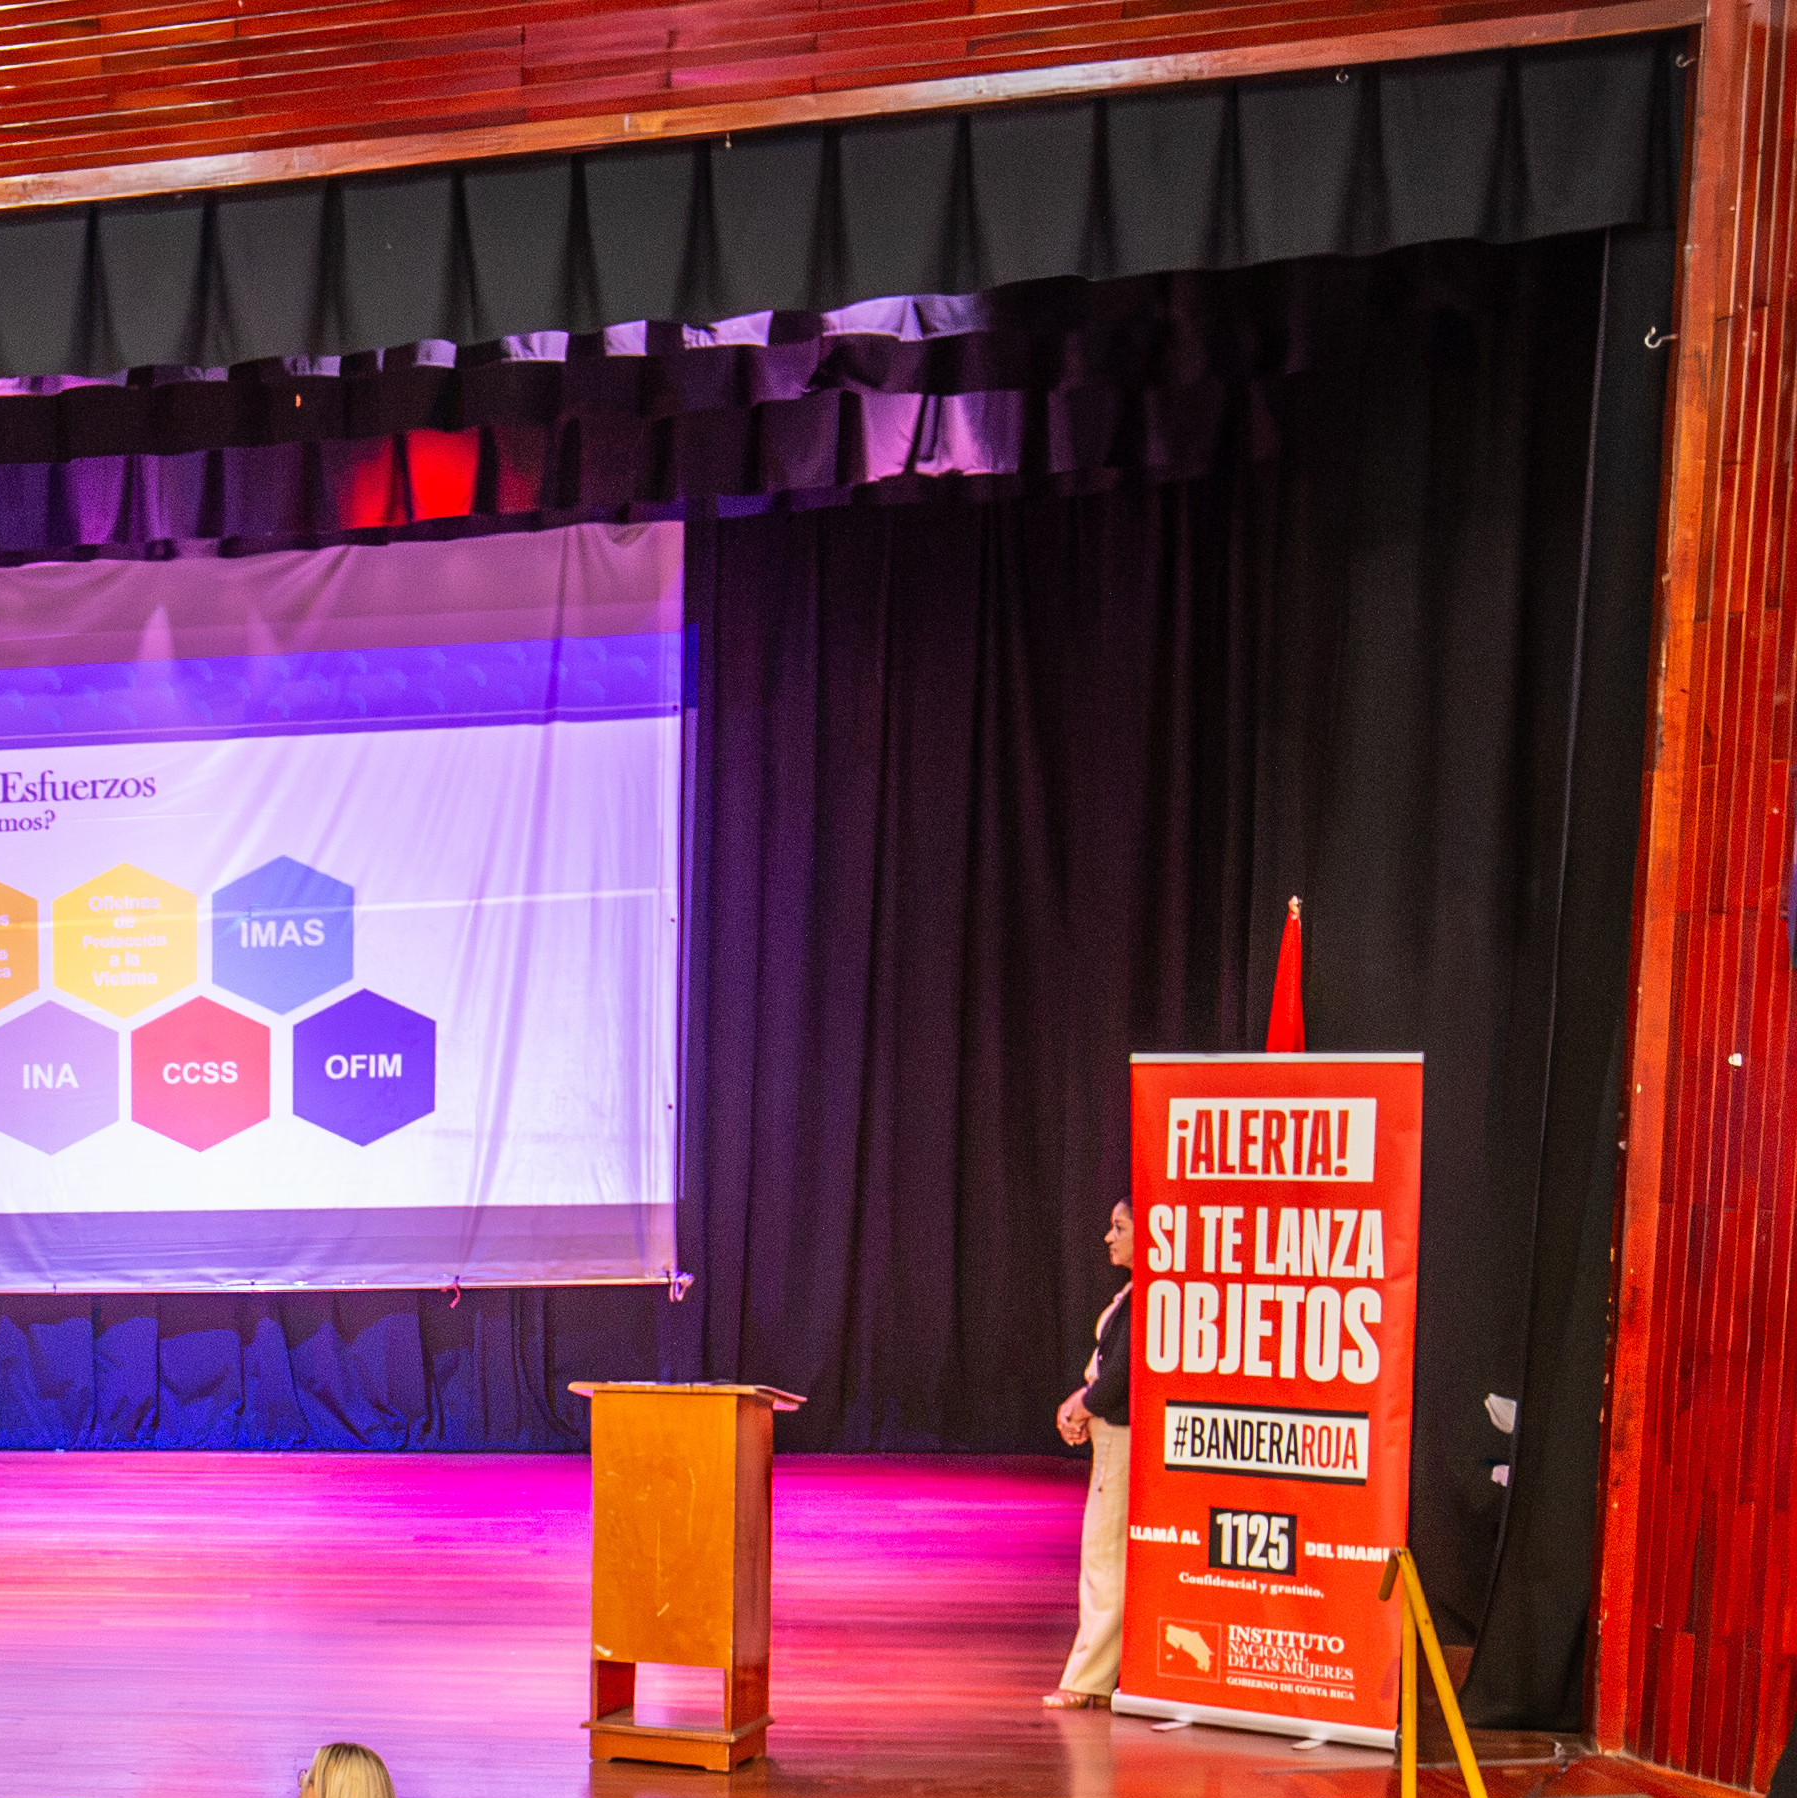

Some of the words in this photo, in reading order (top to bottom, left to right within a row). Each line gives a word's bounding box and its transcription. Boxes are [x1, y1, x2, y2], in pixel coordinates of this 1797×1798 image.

[88, 895, 160, 912] Oficinas
[113, 914, 136, 929] de
[240, 918, 326, 949] IMAS
[82, 934, 166, 949] Protección
[109, 954, 119, 967] a
[125, 951, 140, 966] la
[92, 970, 157, 987] Víctima
[22, 1063, 80, 1090] INA
[162, 1061, 239, 1085] CCSS
[324, 1053, 403, 1079] OFIM
[1176, 1109, 1350, 1179] ¡ALERTA!
[1148, 1203, 1188, 1273] SI
[1199, 1205, 1244, 1274] TE
[1254, 1207, 1385, 1279] LANZA
[1145, 1279, 1382, 1385] OBJETOS
[1173, 1414, 1359, 1471] #BANDERAROJA
[1180, 1529, 1201, 1545] AL
[1216, 1513, 1289, 1570] 1125
[1305, 1542, 1334, 1558] DEL
[1178, 1572, 1257, 1591] Confidencial
[1259, 1581, 1268, 1595] y
[1270, 1582, 1324, 1598] gratuito.
[1228, 1624, 1345, 1654] INSTITUTO
[1228, 1640, 1308, 1662] NACIONAL
[1228, 1653, 1250, 1668] DE
[1252, 1657, 1280, 1672] LAS
[1282, 1659, 1354, 1681] MUJERES
[1226, 1675, 1278, 1691] GOBIERNO
[1280, 1680, 1294, 1692] DE
[1295, 1684, 1328, 1698] COSTA
[1330, 1689, 1355, 1701] RICA
